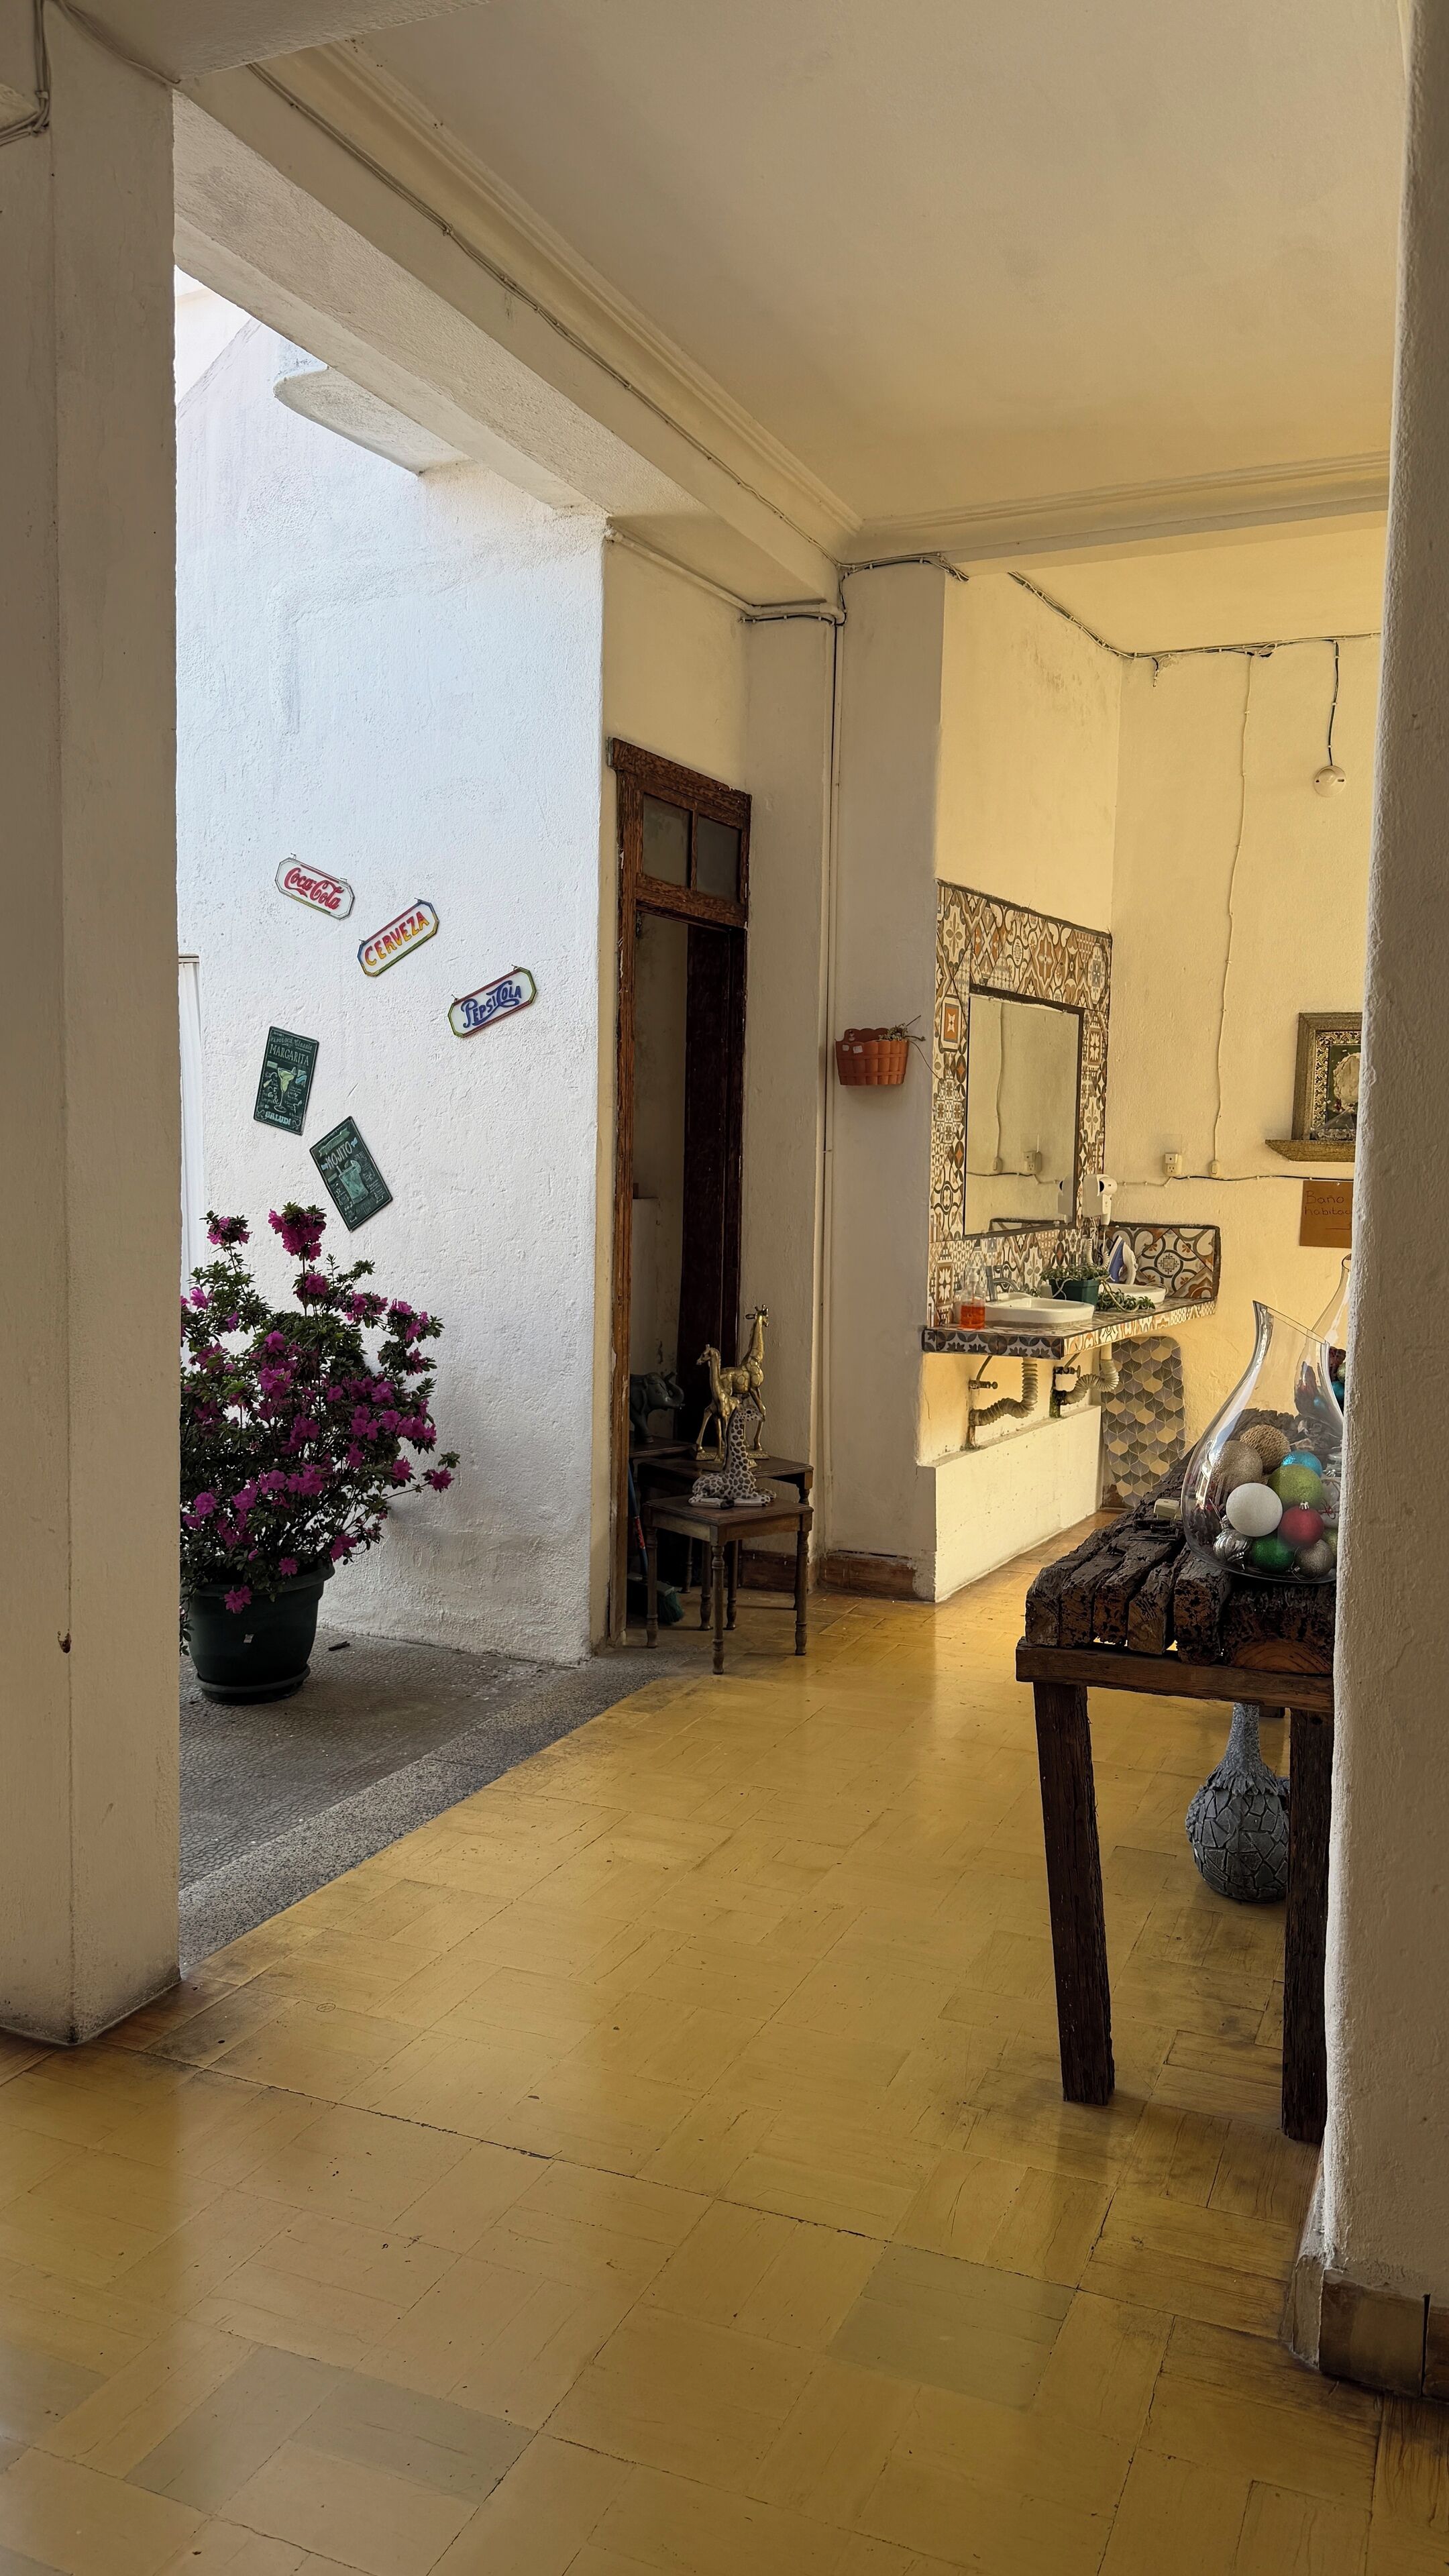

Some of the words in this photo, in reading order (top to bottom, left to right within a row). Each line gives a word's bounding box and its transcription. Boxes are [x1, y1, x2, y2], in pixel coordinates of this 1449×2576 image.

[364, 911, 430, 966] CERVEZA
[269, 1044, 309, 1067] MARGARITA
[325, 1141, 352, 1170] MOJITO
